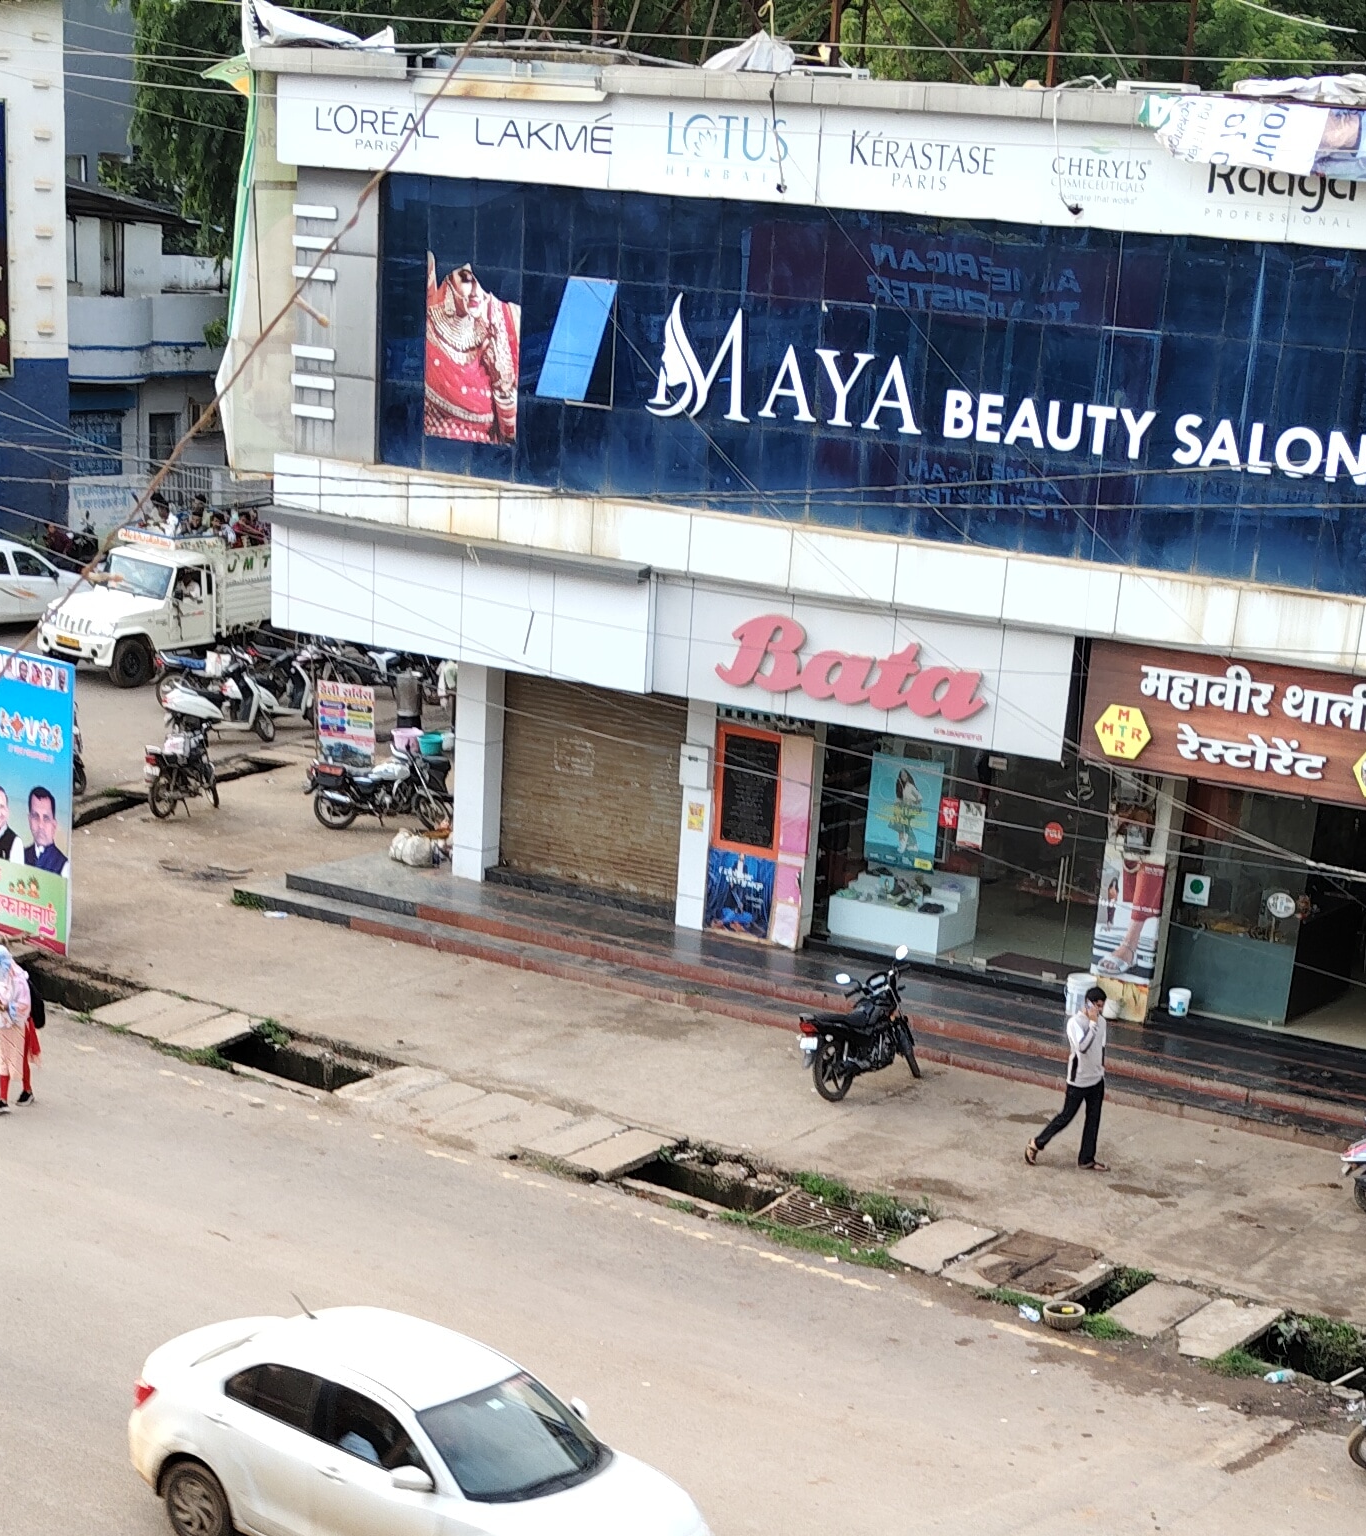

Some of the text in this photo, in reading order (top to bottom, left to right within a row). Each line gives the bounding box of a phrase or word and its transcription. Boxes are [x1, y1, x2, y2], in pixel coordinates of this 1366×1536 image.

[315, 104, 439, 139] L'ORÉAL
[475, 112, 614, 155] LAKMÉ
[666, 111, 789, 163] LOTUS
[355, 138, 399, 153] PARIS
[849, 129, 996, 176] KÉRASTASE
[891, 172, 947, 191] PARIS
[1204, 208, 1353, 228] PROFESSIONAL
[645, 292, 922, 436] MAYA
[942, 389, 1157, 461] BEAUTY
[715, 614, 988, 722] Bata
[1139, 664, 1276, 717] महावीर
[1176, 723, 1327, 780] रेस्टोरेंट
[1045, 826, 1063, 840] PULL
